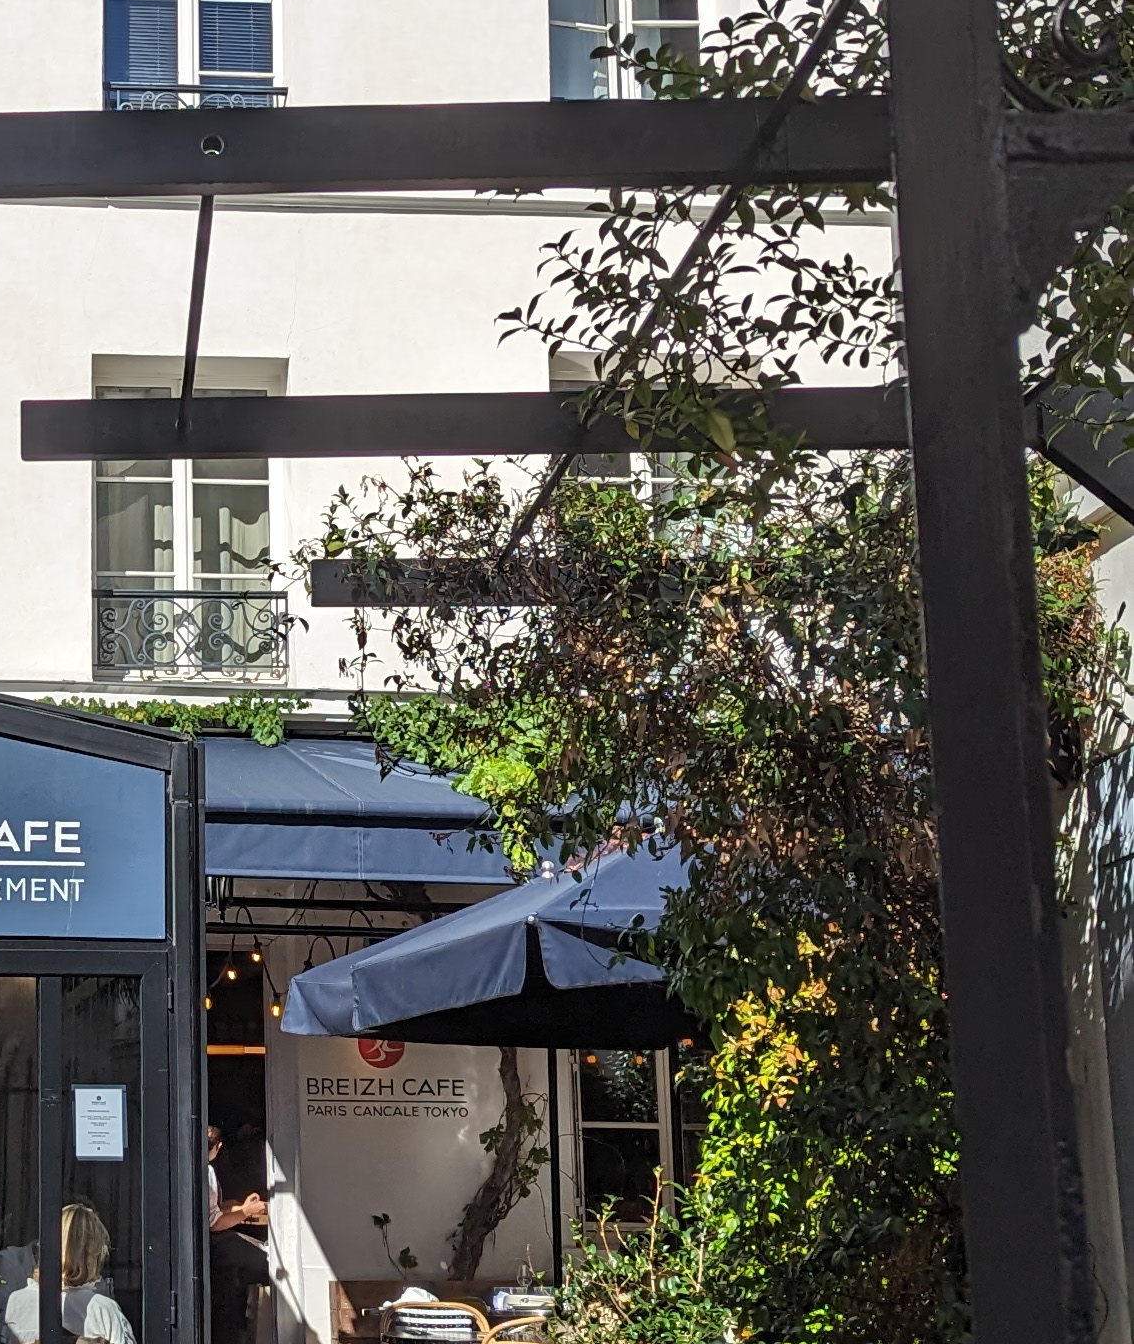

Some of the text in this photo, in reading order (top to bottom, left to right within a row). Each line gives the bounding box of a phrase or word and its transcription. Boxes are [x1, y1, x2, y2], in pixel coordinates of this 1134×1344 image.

[306, 1077, 465, 1097] BREIZH CAFE
[307, 1105, 469, 1118] PARIS CANCALE TOKYO
